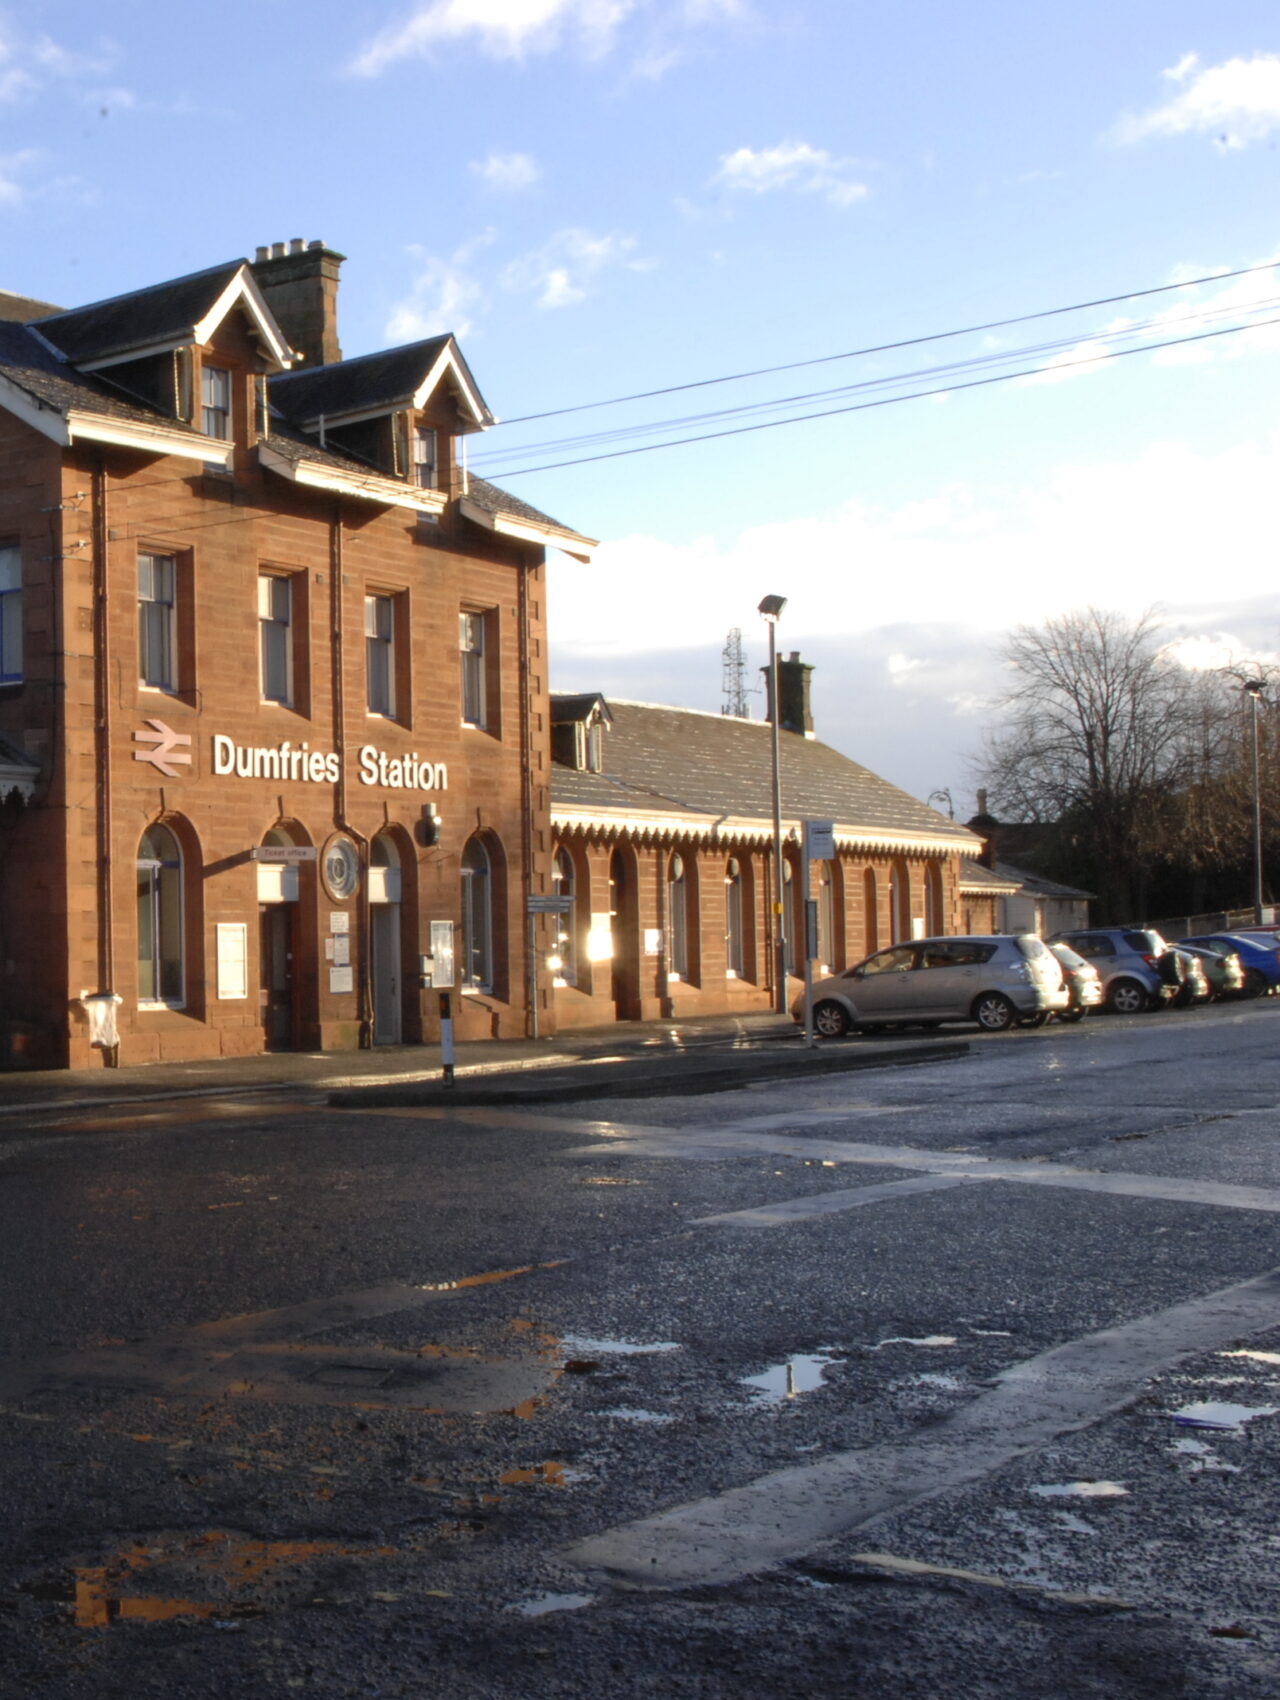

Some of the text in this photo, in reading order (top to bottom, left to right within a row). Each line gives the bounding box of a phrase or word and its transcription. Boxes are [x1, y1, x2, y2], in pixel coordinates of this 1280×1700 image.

[213, 734, 448, 790] Dumfries Station
[264, 848, 285, 857] Ticket
